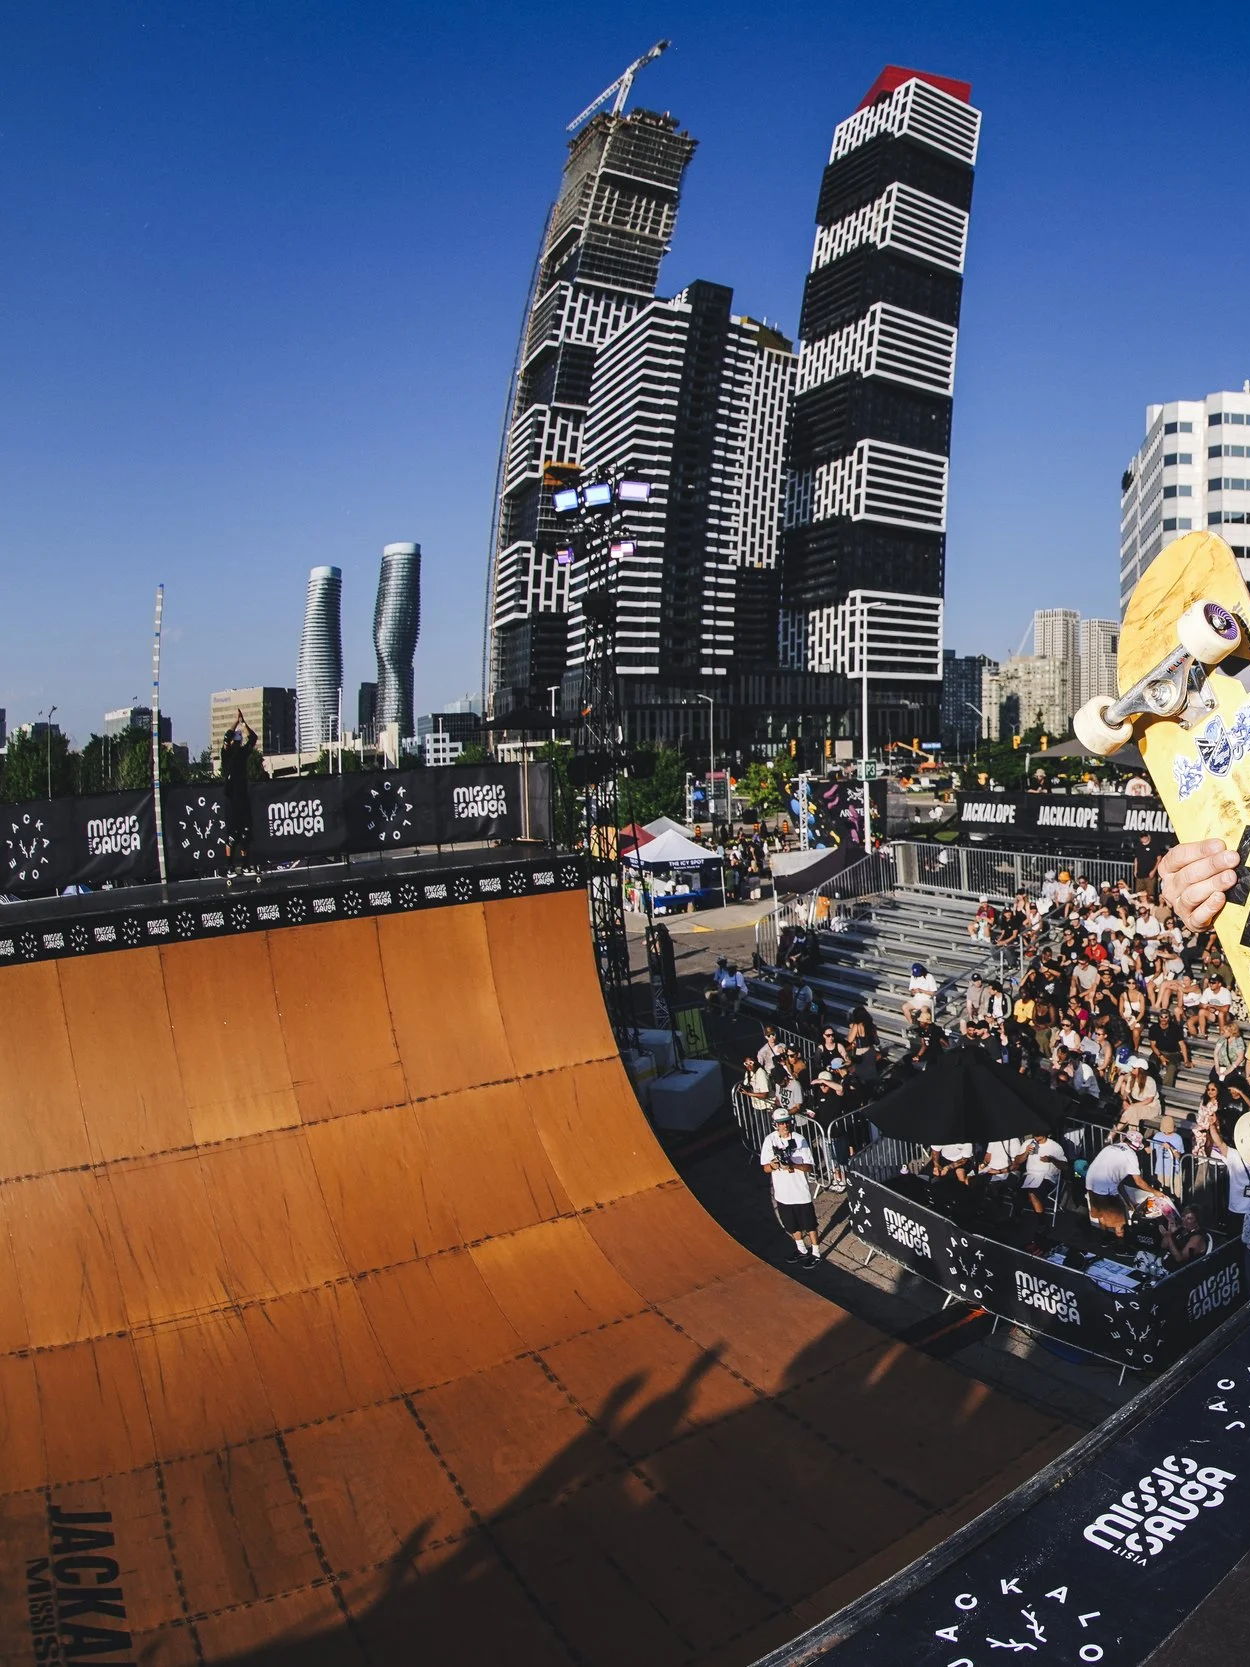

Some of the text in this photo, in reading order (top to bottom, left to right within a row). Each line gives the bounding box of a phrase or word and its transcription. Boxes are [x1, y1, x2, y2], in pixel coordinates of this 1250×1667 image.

[453, 784, 506, 803] MISSIS
[268, 799, 323, 820] MISSIS
[459, 800, 507, 819] SAUGA
[961, 802, 1016, 824] JACKALOPE
[1037, 805, 1099, 829] JACKALOPE
[87, 815, 140, 838] MISSIS
[273, 816, 325, 837] SAUGA
[92, 833, 141, 856] SAUGA
[883, 1207, 929, 1242] MISSIS
[889, 1223, 932, 1259] SAUGA
[1014, 1270, 1078, 1307] MISSIS
[1020, 1287, 1081, 1326] SAUGA
[1083, 1455, 1198, 1551] MISSIS
[1125, 1466, 1237, 1556] SAUGA
[1112, 1546, 1147, 1567] VISIT
[48, 1505, 138, 1667] JACKA
[25, 1557, 62, 1667] MISSIS
